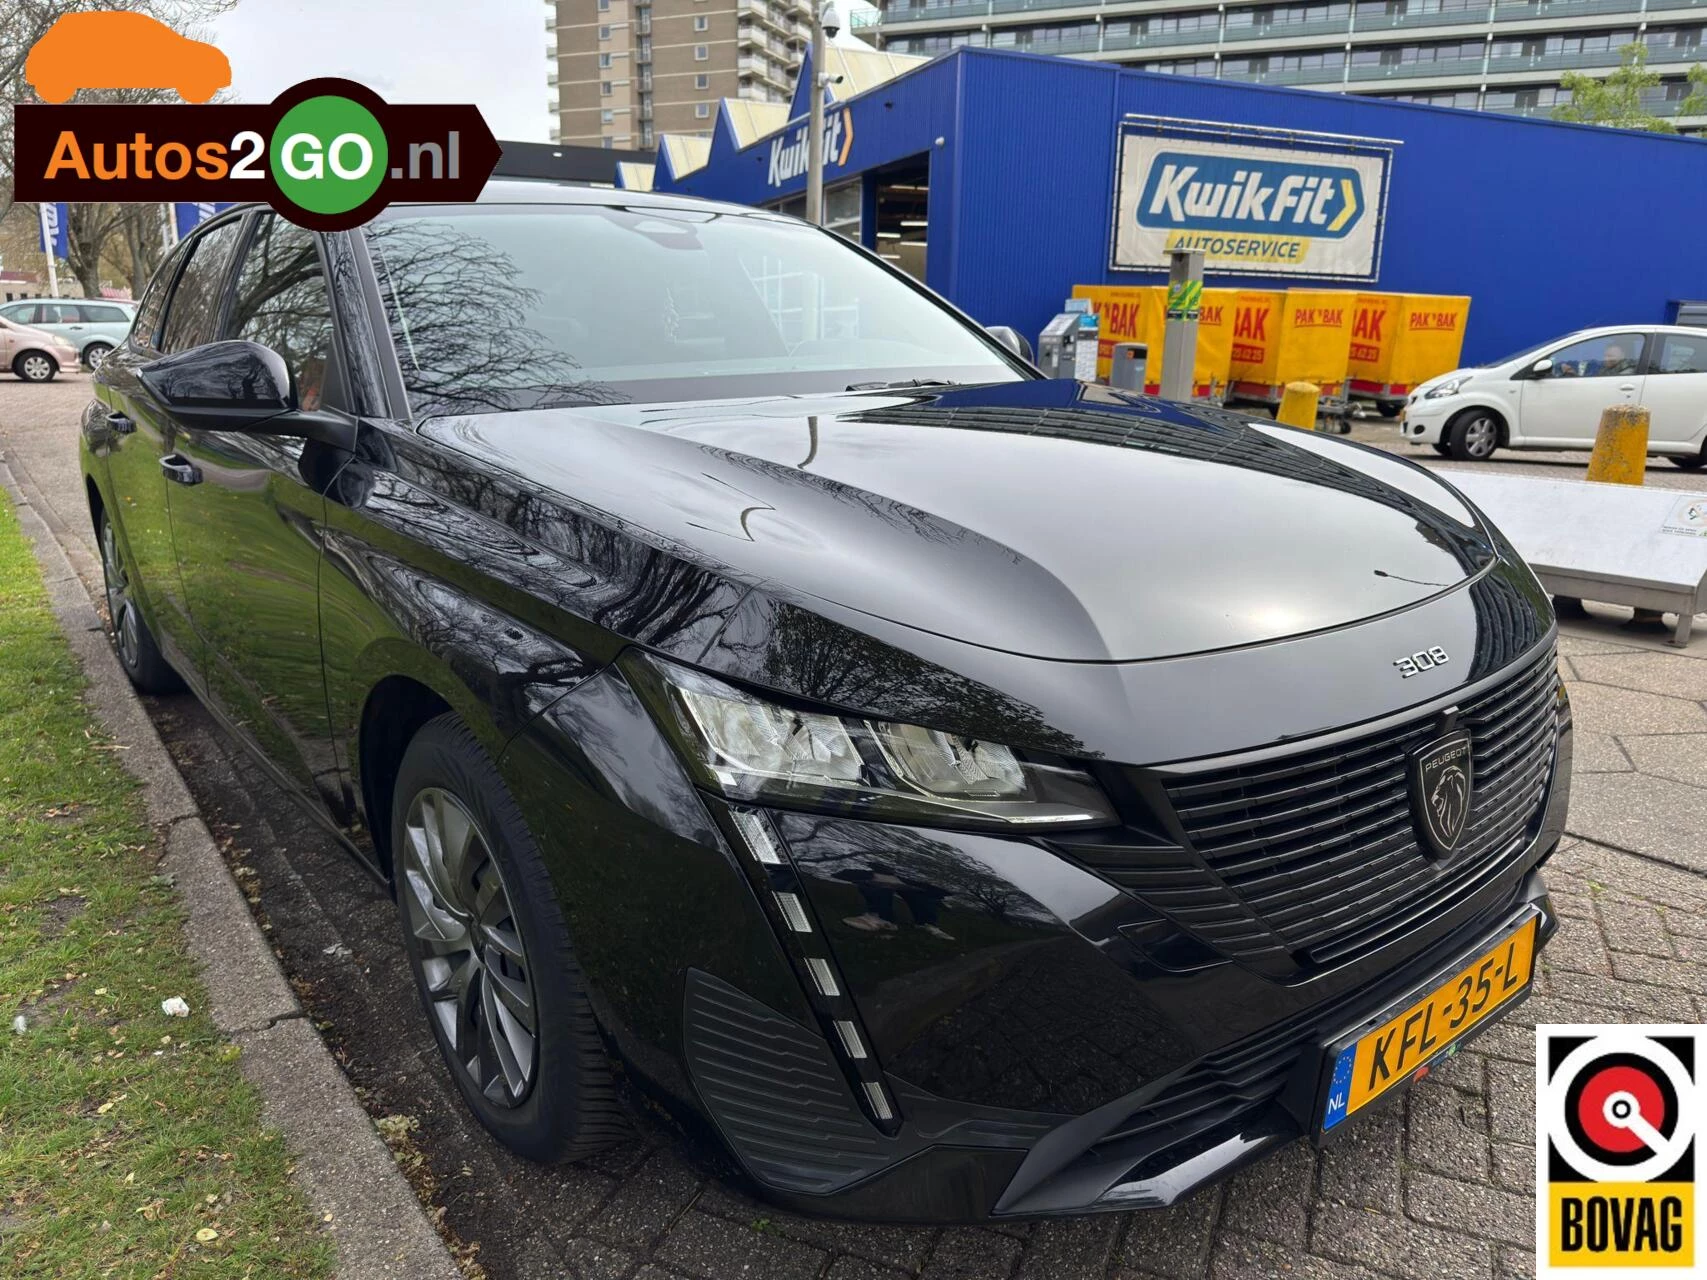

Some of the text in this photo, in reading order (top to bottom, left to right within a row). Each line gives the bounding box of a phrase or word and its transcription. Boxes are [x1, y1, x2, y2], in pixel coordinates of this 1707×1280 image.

[1174, 236, 1301, 259] AUTOSERVICE
[1109, 303, 1140, 339] BAK
[1393, 645, 1450, 679] 308
[1424, 746, 1468, 773] PEUGEOT
[1368, 942, 1518, 1092] KFL-35-L
[1327, 1092, 1345, 1115] NL
